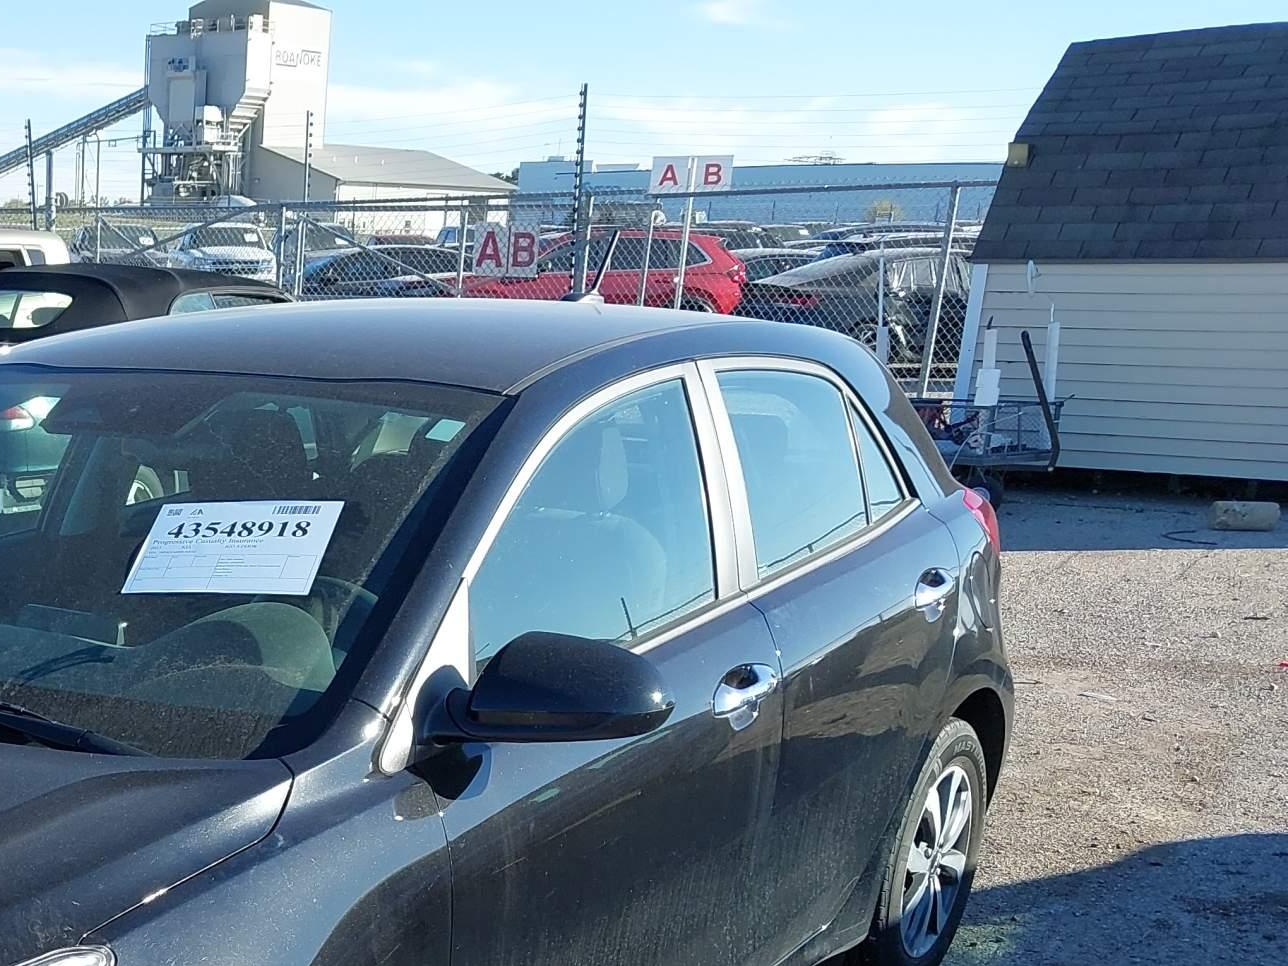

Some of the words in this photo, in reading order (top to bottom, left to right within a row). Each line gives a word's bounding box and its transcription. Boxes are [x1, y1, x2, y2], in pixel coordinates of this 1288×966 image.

[275, 50, 321, 67] ROANOKE
[658, 164, 679, 186] A
[703, 163, 722, 186] B
[475, 230, 503, 268] A
[512, 231, 536, 268] B
[167, 520, 312, 539] 43548918
